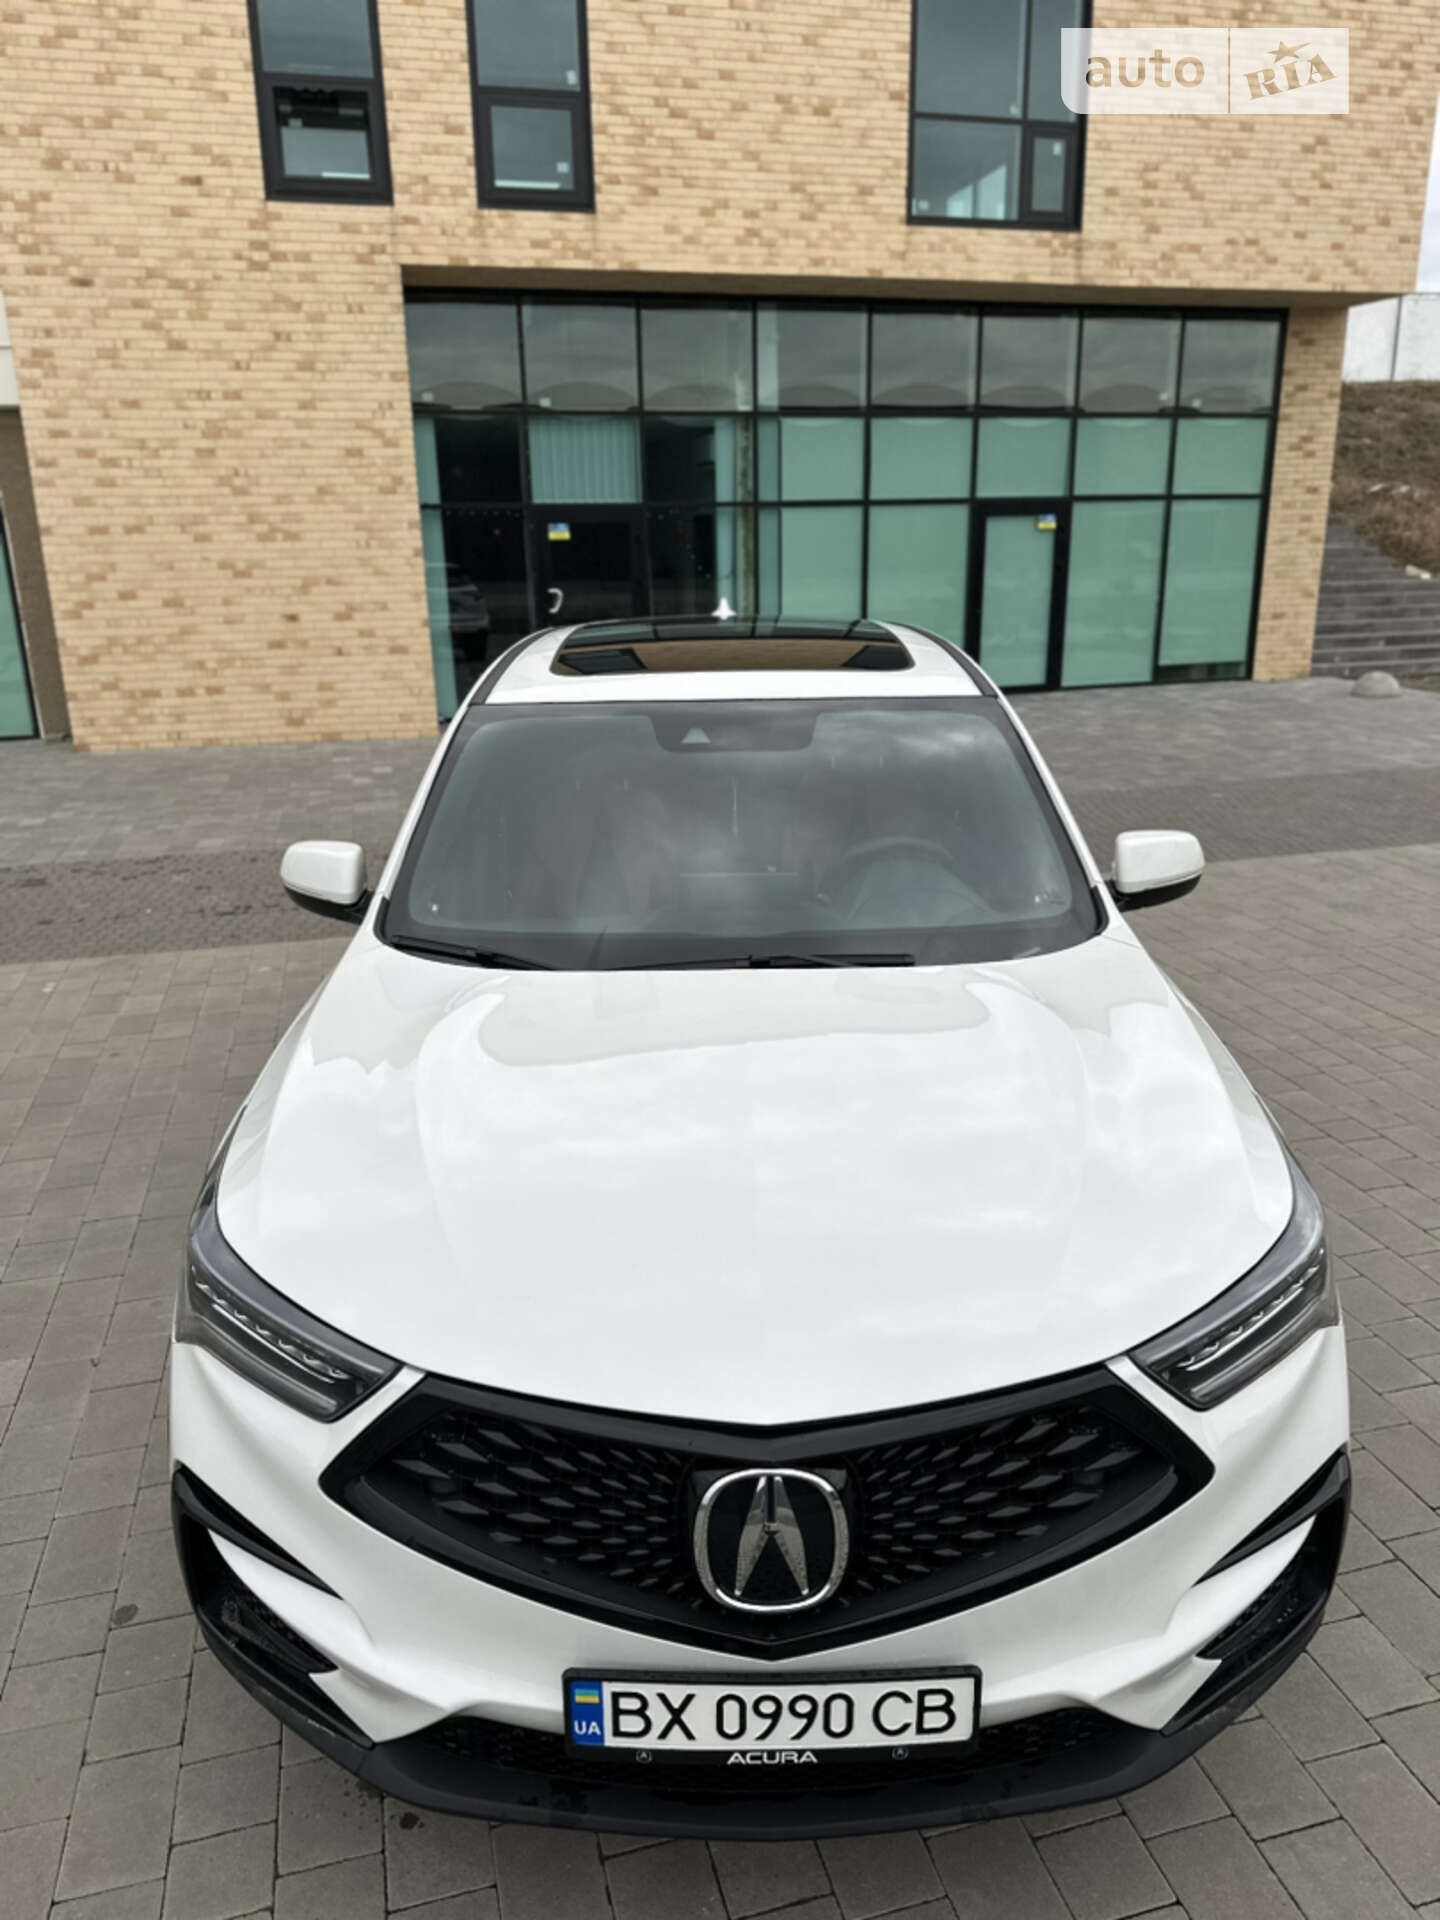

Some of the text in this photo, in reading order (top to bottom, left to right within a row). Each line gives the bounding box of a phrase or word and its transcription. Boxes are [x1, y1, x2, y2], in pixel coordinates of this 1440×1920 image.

[611, 1688, 956, 1740] BX 0990 CB
[573, 1720, 601, 1736] UA
[727, 1751, 818, 1765] ACURA
